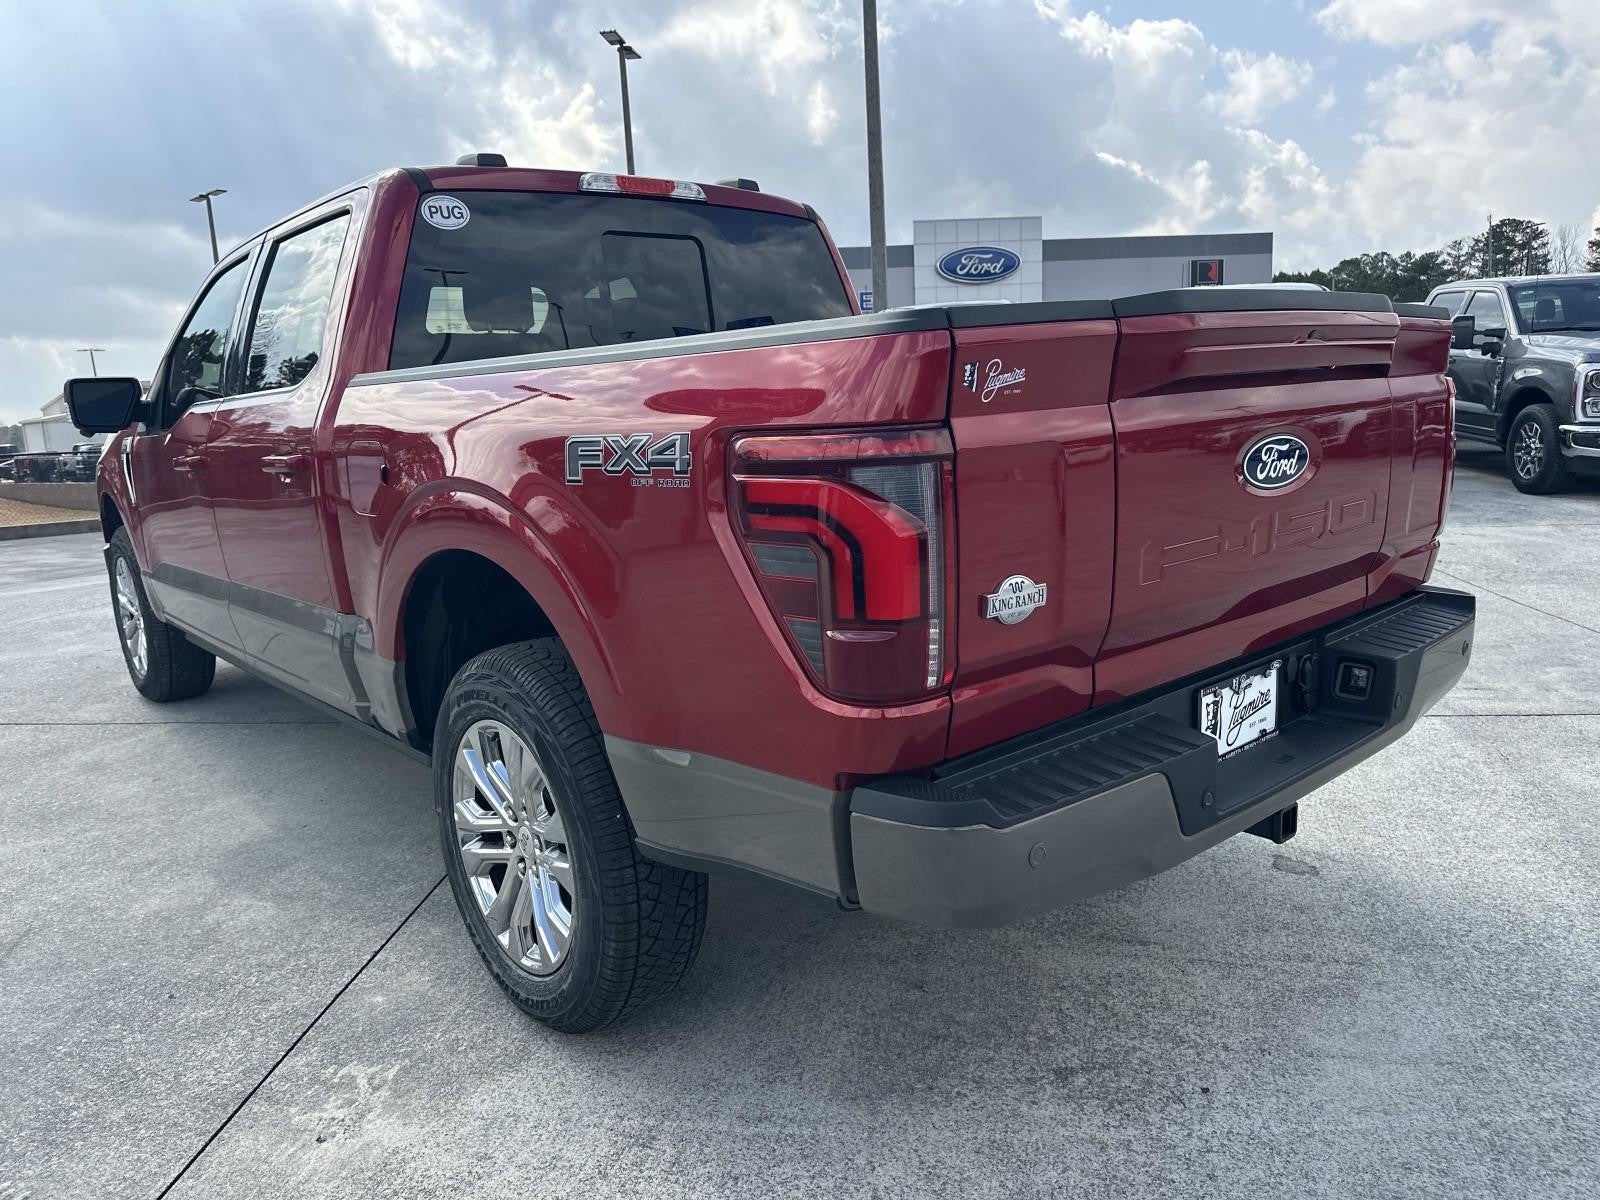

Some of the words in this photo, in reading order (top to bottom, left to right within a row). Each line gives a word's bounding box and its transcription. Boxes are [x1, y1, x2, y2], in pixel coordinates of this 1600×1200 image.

[427, 205, 464, 219] PUG
[956, 253, 1004, 275] Ford
[981, 358, 1026, 402] Pugmire
[565, 432, 692, 485] FX4
[1256, 443, 1300, 480] Ford
[631, 478, 654, 487] OFF
[657, 478, 690, 488] ROAD
[991, 596, 1014, 613] KING
[1015, 588, 1044, 608] RANCH
[1226, 684, 1272, 747] Pugmire
